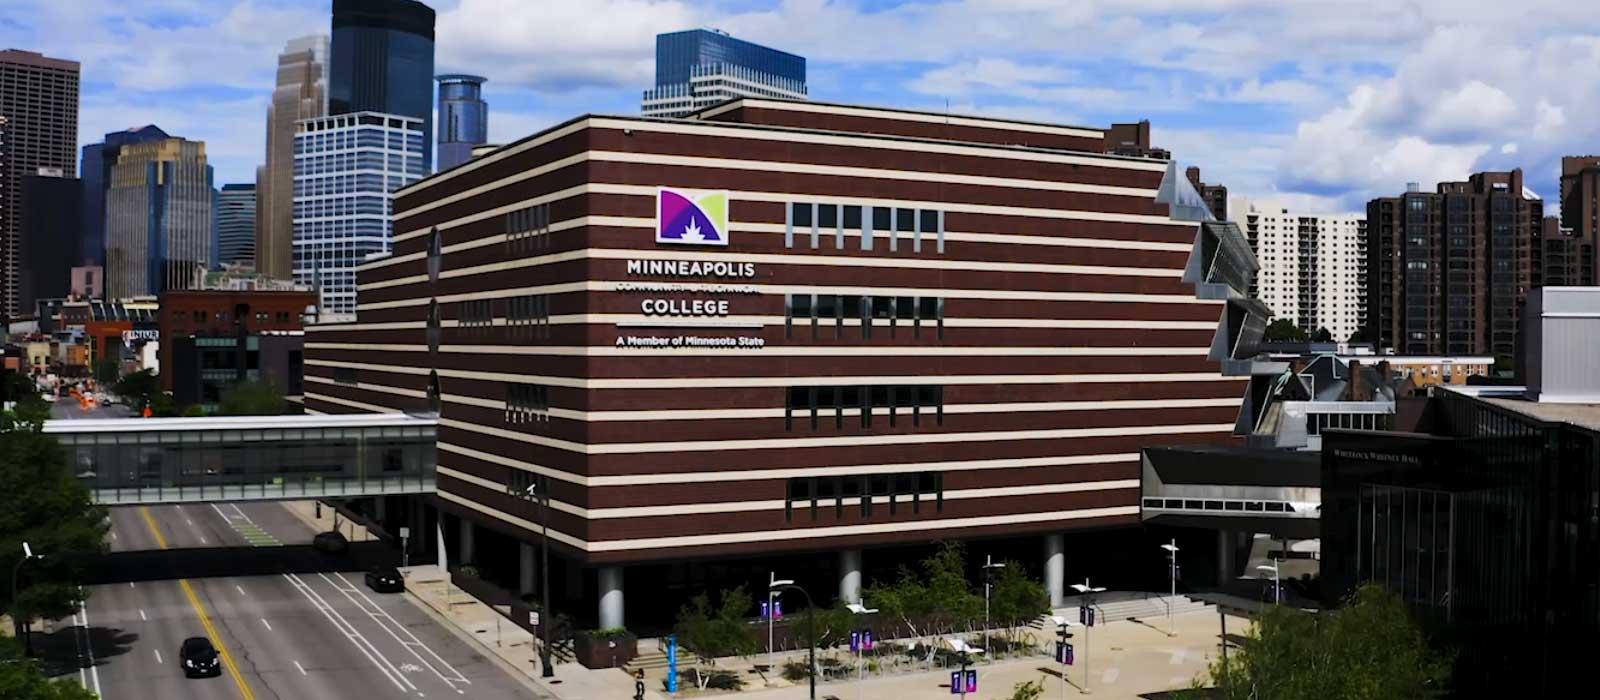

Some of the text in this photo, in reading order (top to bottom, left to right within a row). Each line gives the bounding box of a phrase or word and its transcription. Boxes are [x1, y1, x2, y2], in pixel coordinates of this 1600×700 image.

[627, 260, 755, 277] MINNEAPOLIS
[641, 299, 729, 314] COLLEGE
[616, 336, 765, 346] A Member of Minnesota State
